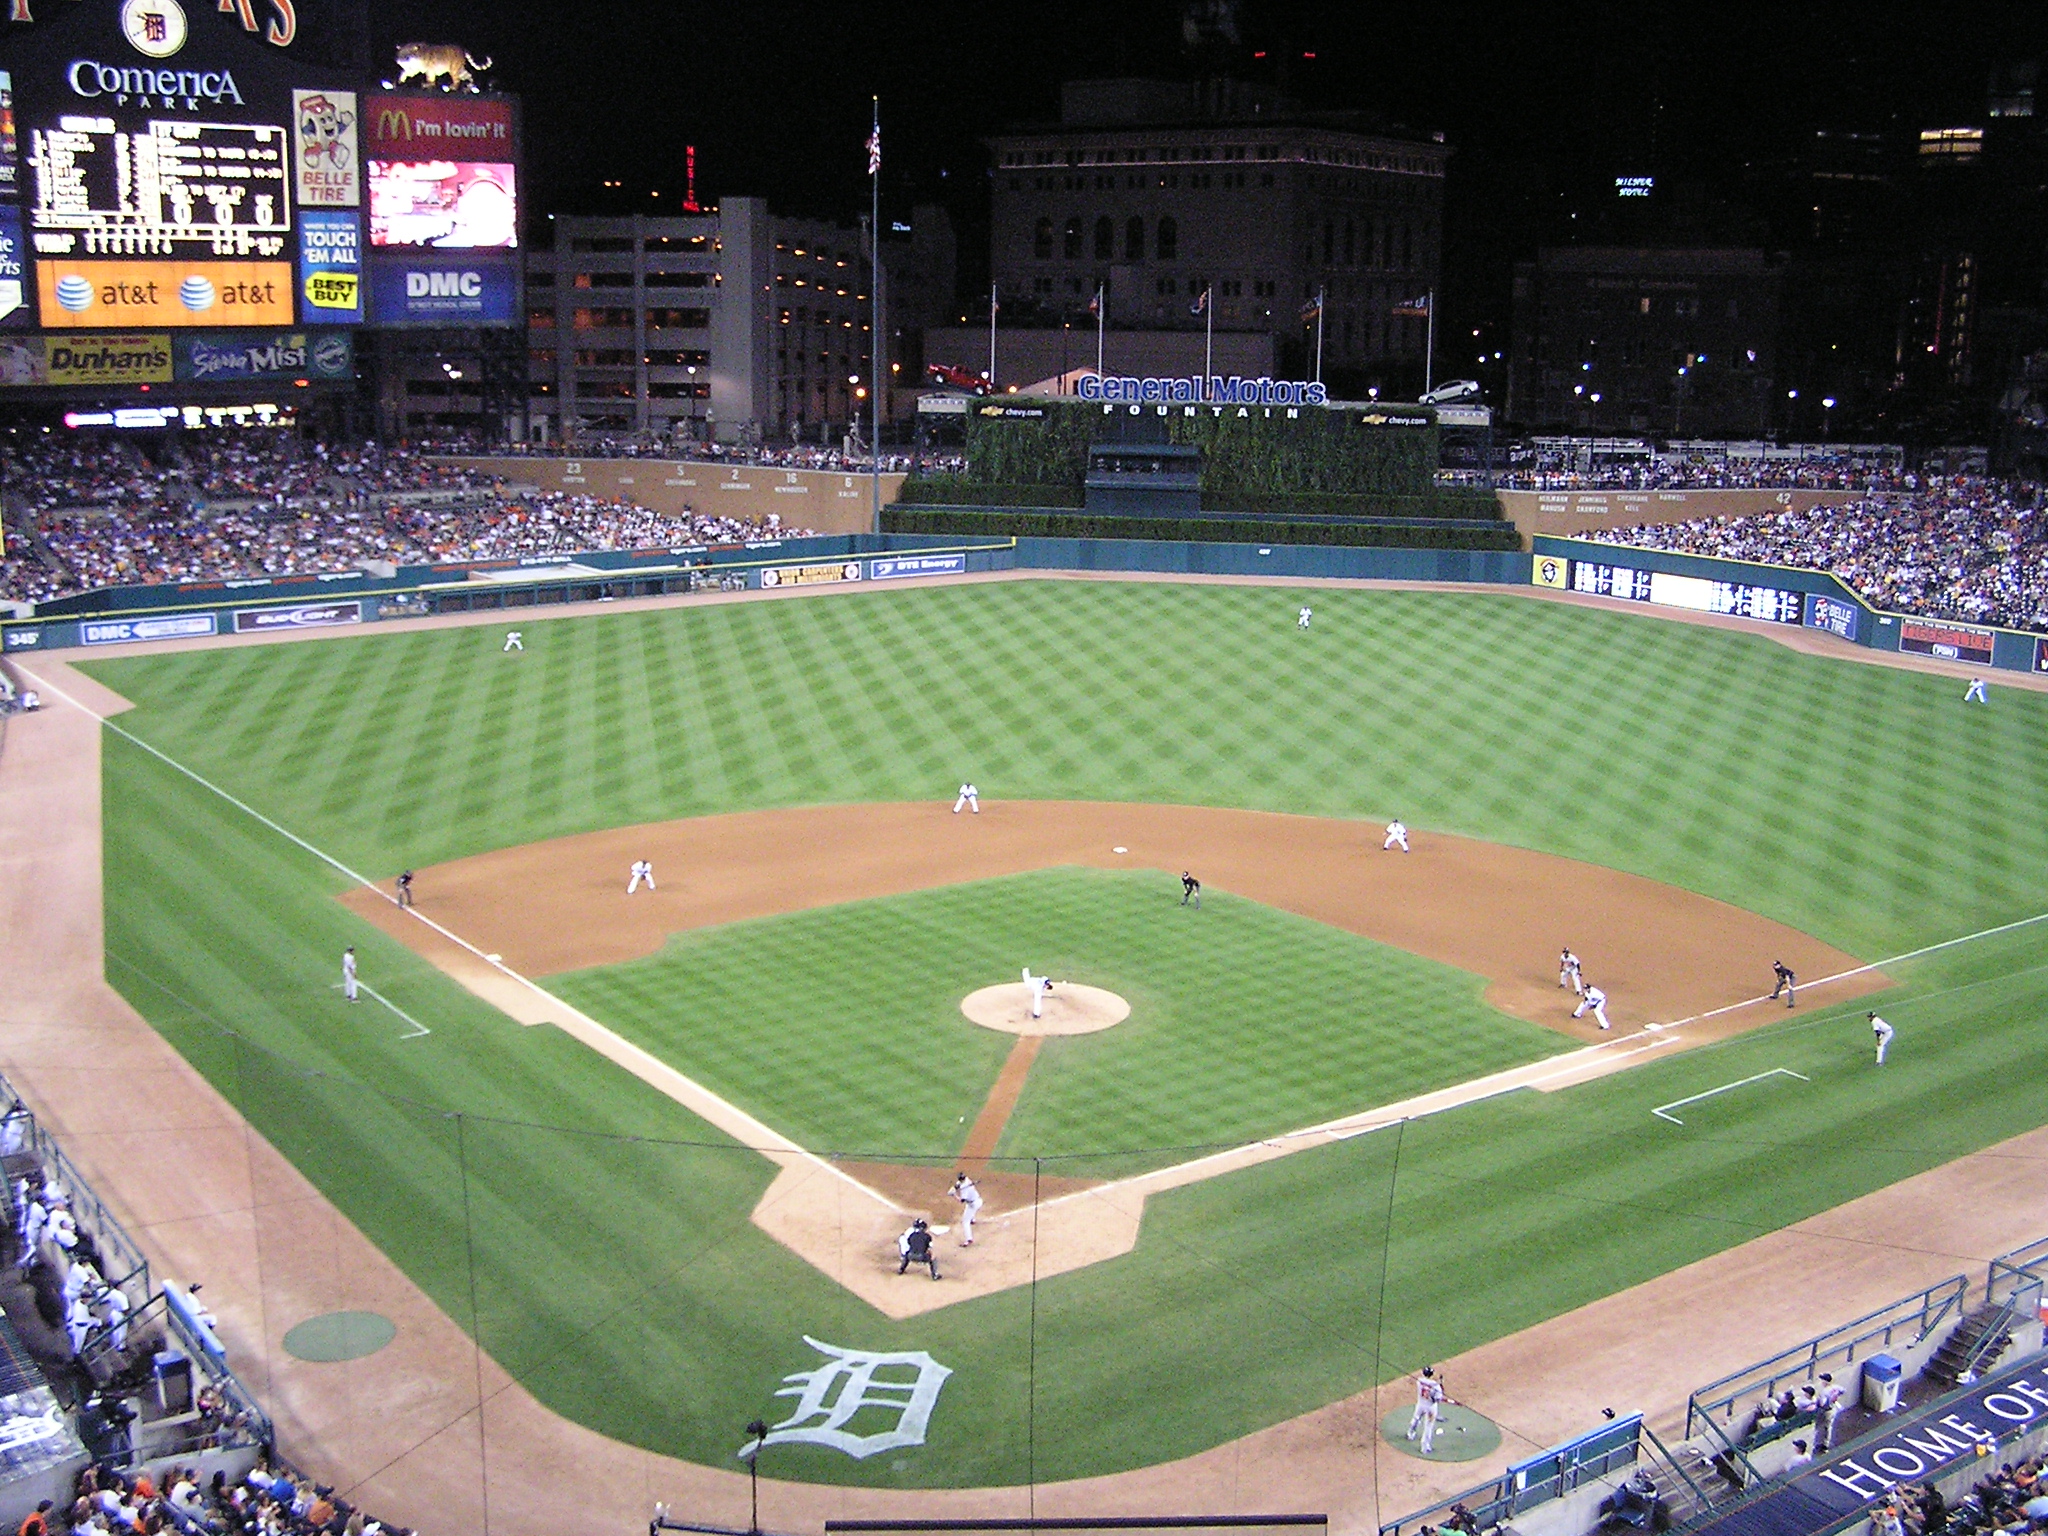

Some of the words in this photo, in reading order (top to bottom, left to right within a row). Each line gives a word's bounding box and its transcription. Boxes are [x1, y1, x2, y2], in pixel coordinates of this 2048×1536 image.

[117, 93, 200, 111] PARK
[303, 171, 353, 187] BELLE
[309, 187, 345, 202] TIRE
[304, 231, 357, 247] TOUCH
[331, 248, 357, 264] ALL
[313, 279, 357, 292] BEST
[406, 271, 482, 297] DMC
[101, 281, 159, 306] at&t
[222, 281, 276, 306] at&t
[315, 290, 350, 302] BUY
[51, 346, 168, 370] Dunham's
[246, 345, 307, 374] Mist
[1077, 373, 1204, 403] General
[1210, 375, 1328, 406] Motors
[1005, 409, 1043, 418] chevy.com
[1103, 404, 1299, 419] FOUNTAIN
[1388, 416, 1427, 426] chevy.com
[566, 462, 581, 474] 23
[677, 465, 685, 476] 5
[731, 469, 740, 480] 2
[1776, 493, 1791, 504] 42
[921, 559, 959, 569] Energy
[1829, 604, 1852, 623] BELLE
[87, 624, 132, 641] DMC
[1831, 618, 1848, 635] TIRE
[1903, 625, 1956, 645] TIGERS
[1819, 1413, 1993, 1499] HOME
